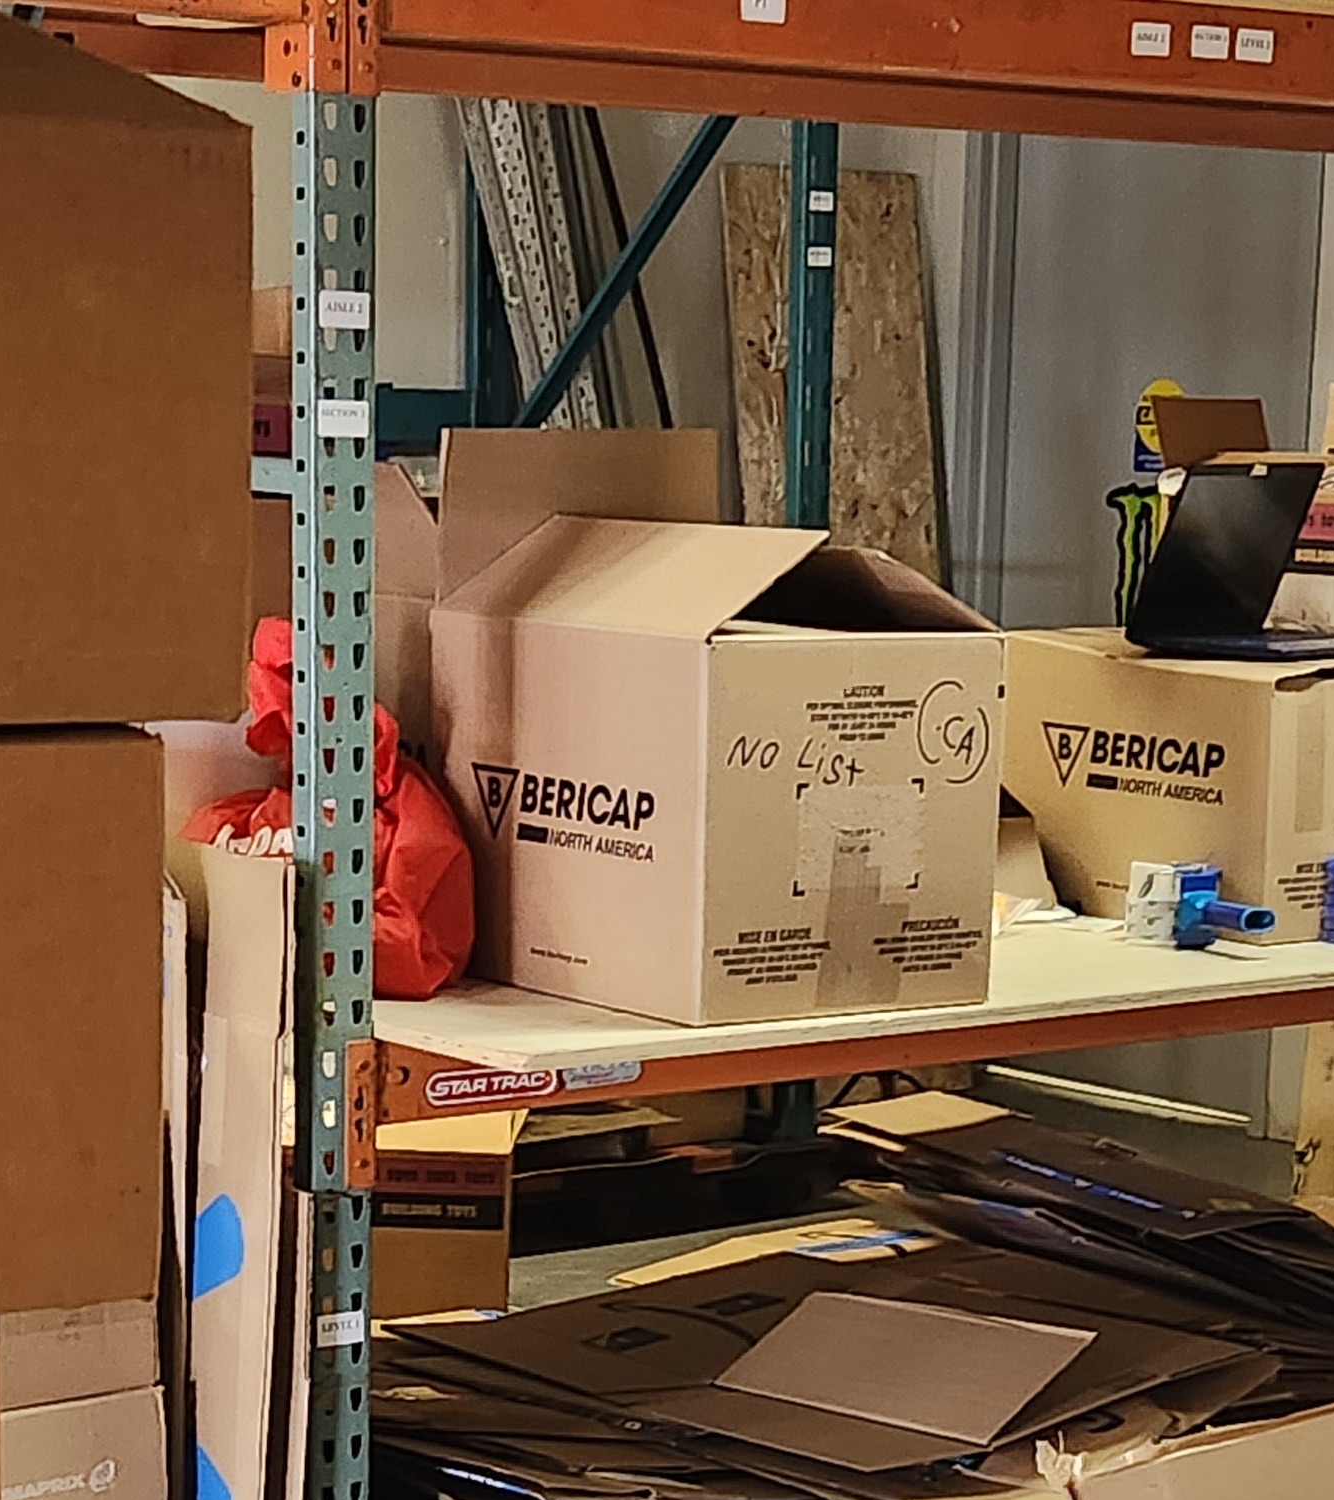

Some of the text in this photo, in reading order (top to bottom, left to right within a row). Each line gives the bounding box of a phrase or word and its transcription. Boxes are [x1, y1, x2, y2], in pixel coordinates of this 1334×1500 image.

[325, 302, 355, 313] AISLE
[1089, 729, 1226, 779] BERICAP
[519, 773, 655, 831] BERICAP
[1119, 777, 1224, 806] NORTH AMERICA
[548, 828, 655, 863] NORTH AMERICA
[433, 1076, 487, 1097] STAR
[489, 1071, 547, 1092] TRAC
